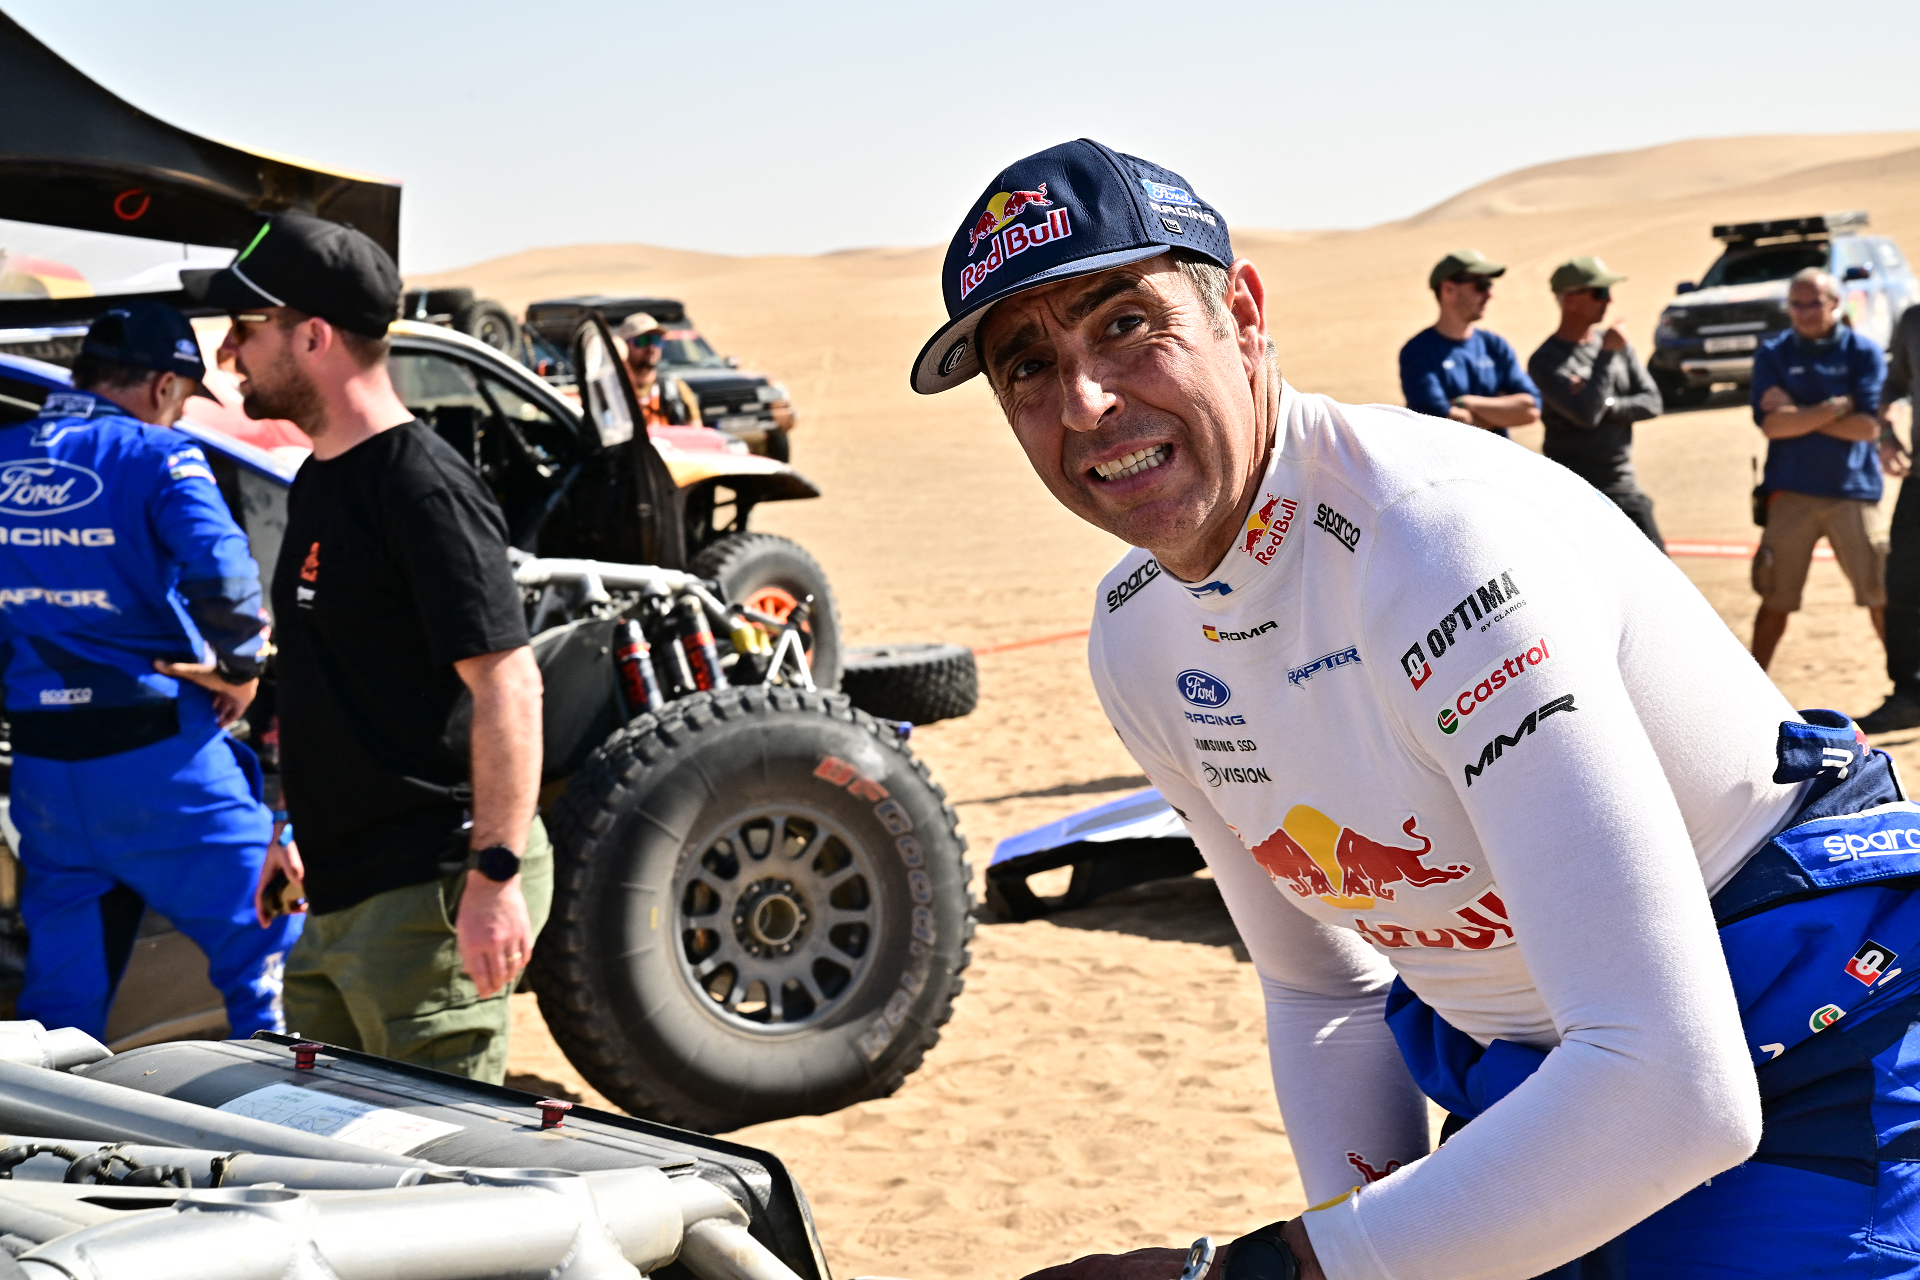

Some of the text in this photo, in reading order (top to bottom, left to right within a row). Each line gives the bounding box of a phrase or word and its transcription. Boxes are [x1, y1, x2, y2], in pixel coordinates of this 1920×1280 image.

[1153, 185, 1193, 203] Ford
[1149, 201, 1216, 227] RACING
[960, 206, 1072, 300] Red Bull
[0, 466, 76, 506] Ford
[1254, 498, 1299, 566] Red Bull
[1314, 502, 1361, 552] sparco
[1106, 557, 1161, 613] sparc
[1218, 620, 1279, 641] ROMA
[1426, 569, 1521, 659] OPTIMA
[1480, 599, 1527, 633] BY CLARIOS
[1185, 674, 1218, 703] Ford
[1456, 637, 1550, 716] Castrol
[39, 687, 92, 705] sparco
[1184, 710, 1246, 726] RACING
[1236, 739, 1257, 752] SSD
[1464, 693, 1579, 788] MMR
[1219, 767, 1272, 784] VISION
